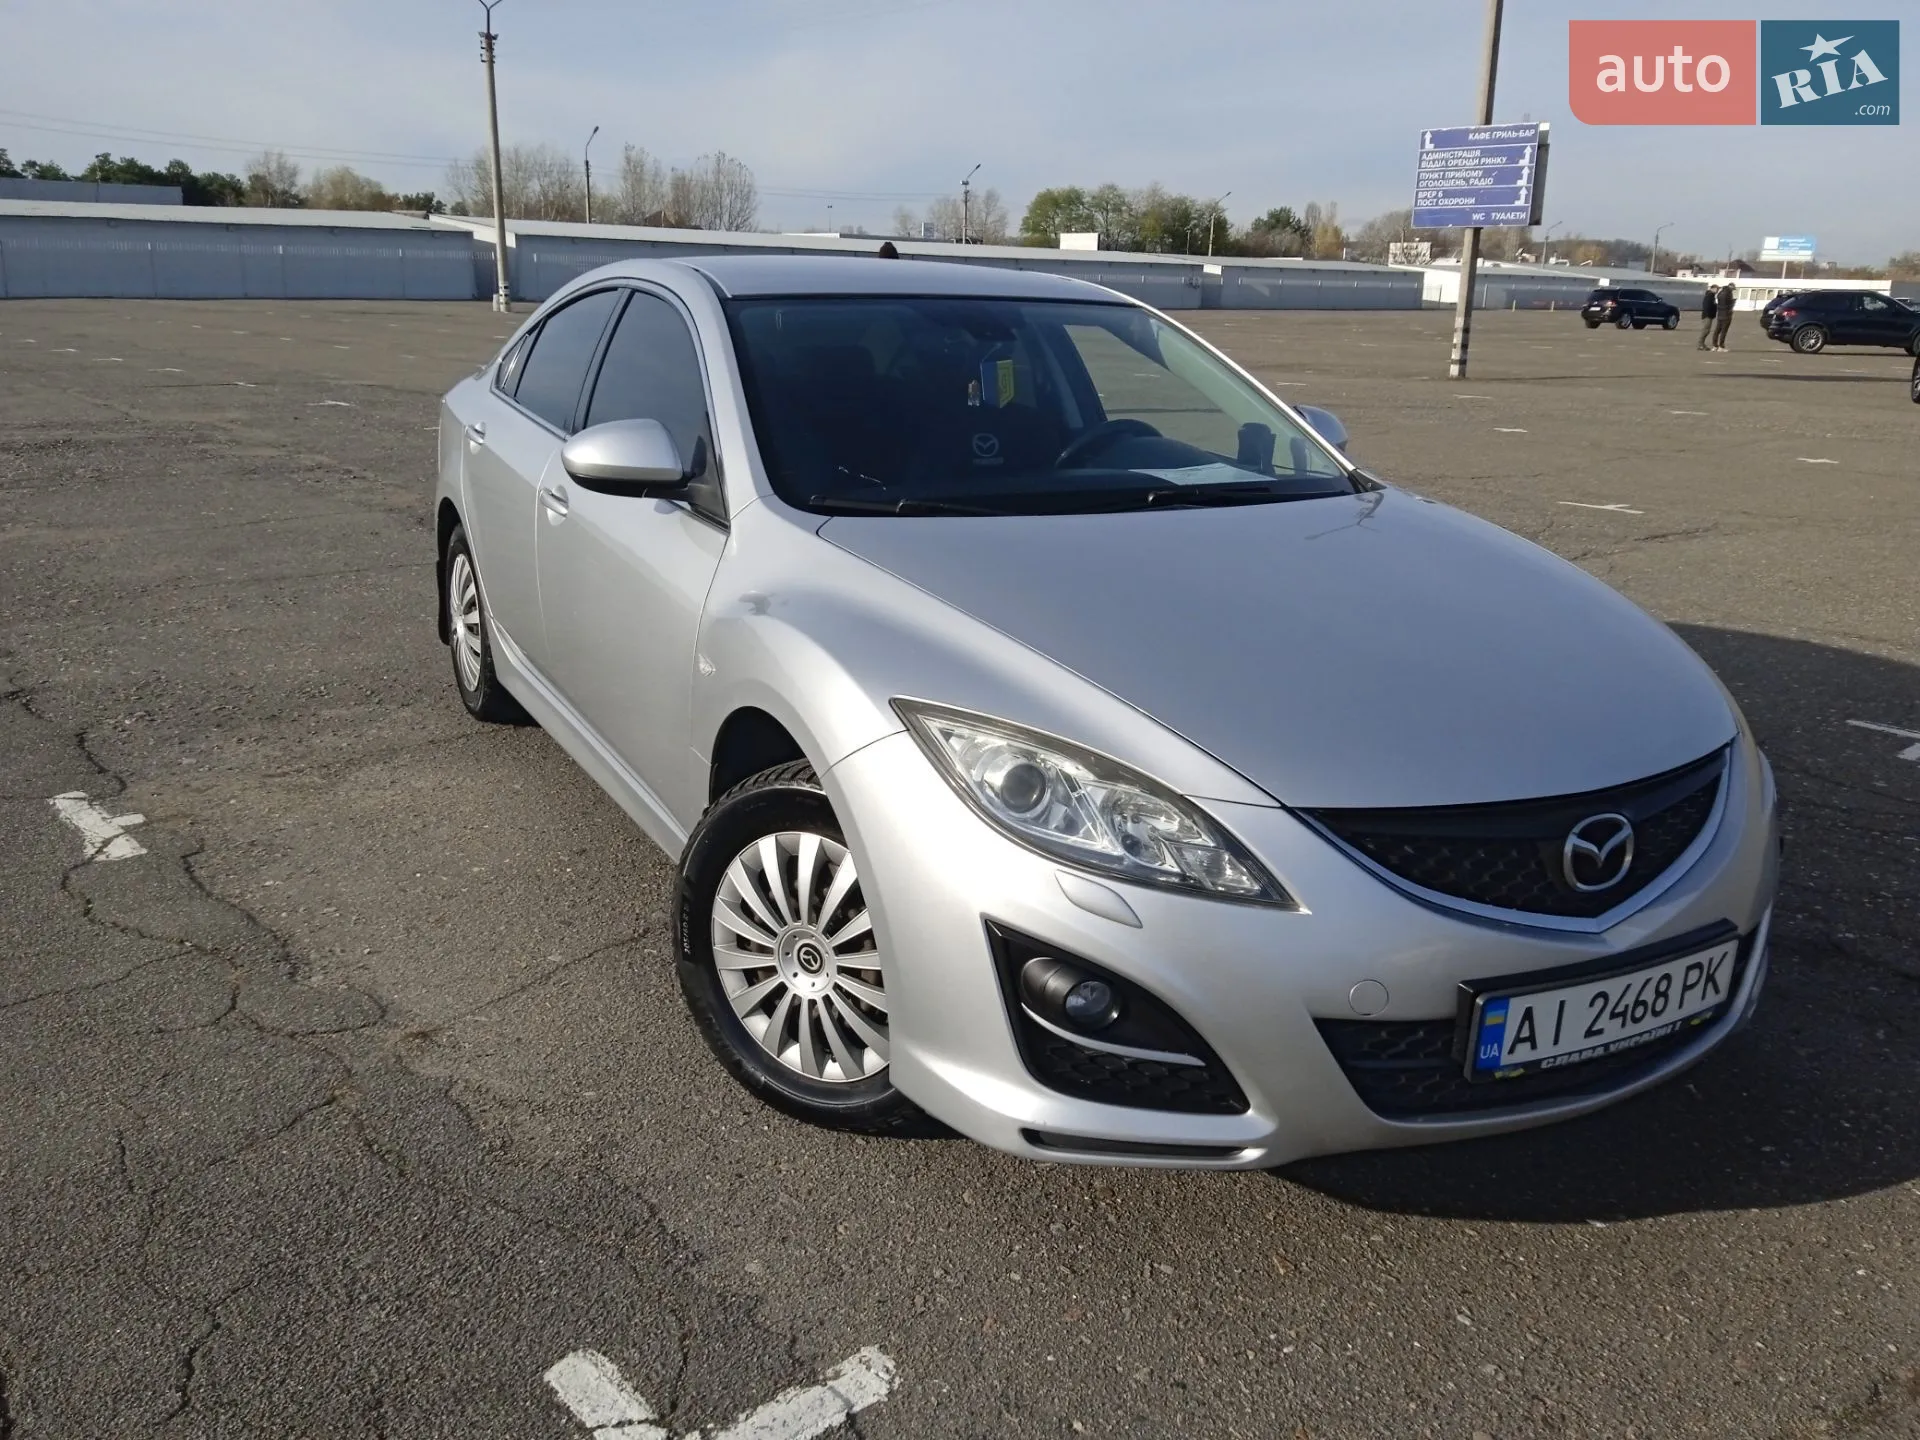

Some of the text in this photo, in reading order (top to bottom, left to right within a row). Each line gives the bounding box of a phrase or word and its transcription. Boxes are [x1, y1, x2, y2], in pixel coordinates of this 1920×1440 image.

[1468, 129, 1535, 141] КАФЕ ГРИЛЬ-БАР
[1480, 156, 1508, 165] РИНКУ
[1419, 170, 1483, 180] ПУНКТ ПРИЙОМУ
[1417, 197, 1476, 207] ПОСТ ОХОРОНИ
[1491, 212, 1526, 220] ТУАЛЕТИ
[1583, 972, 1673, 1040] 2468
[1678, 951, 1729, 1010] PK
[1480, 1043, 1499, 1059] UA
